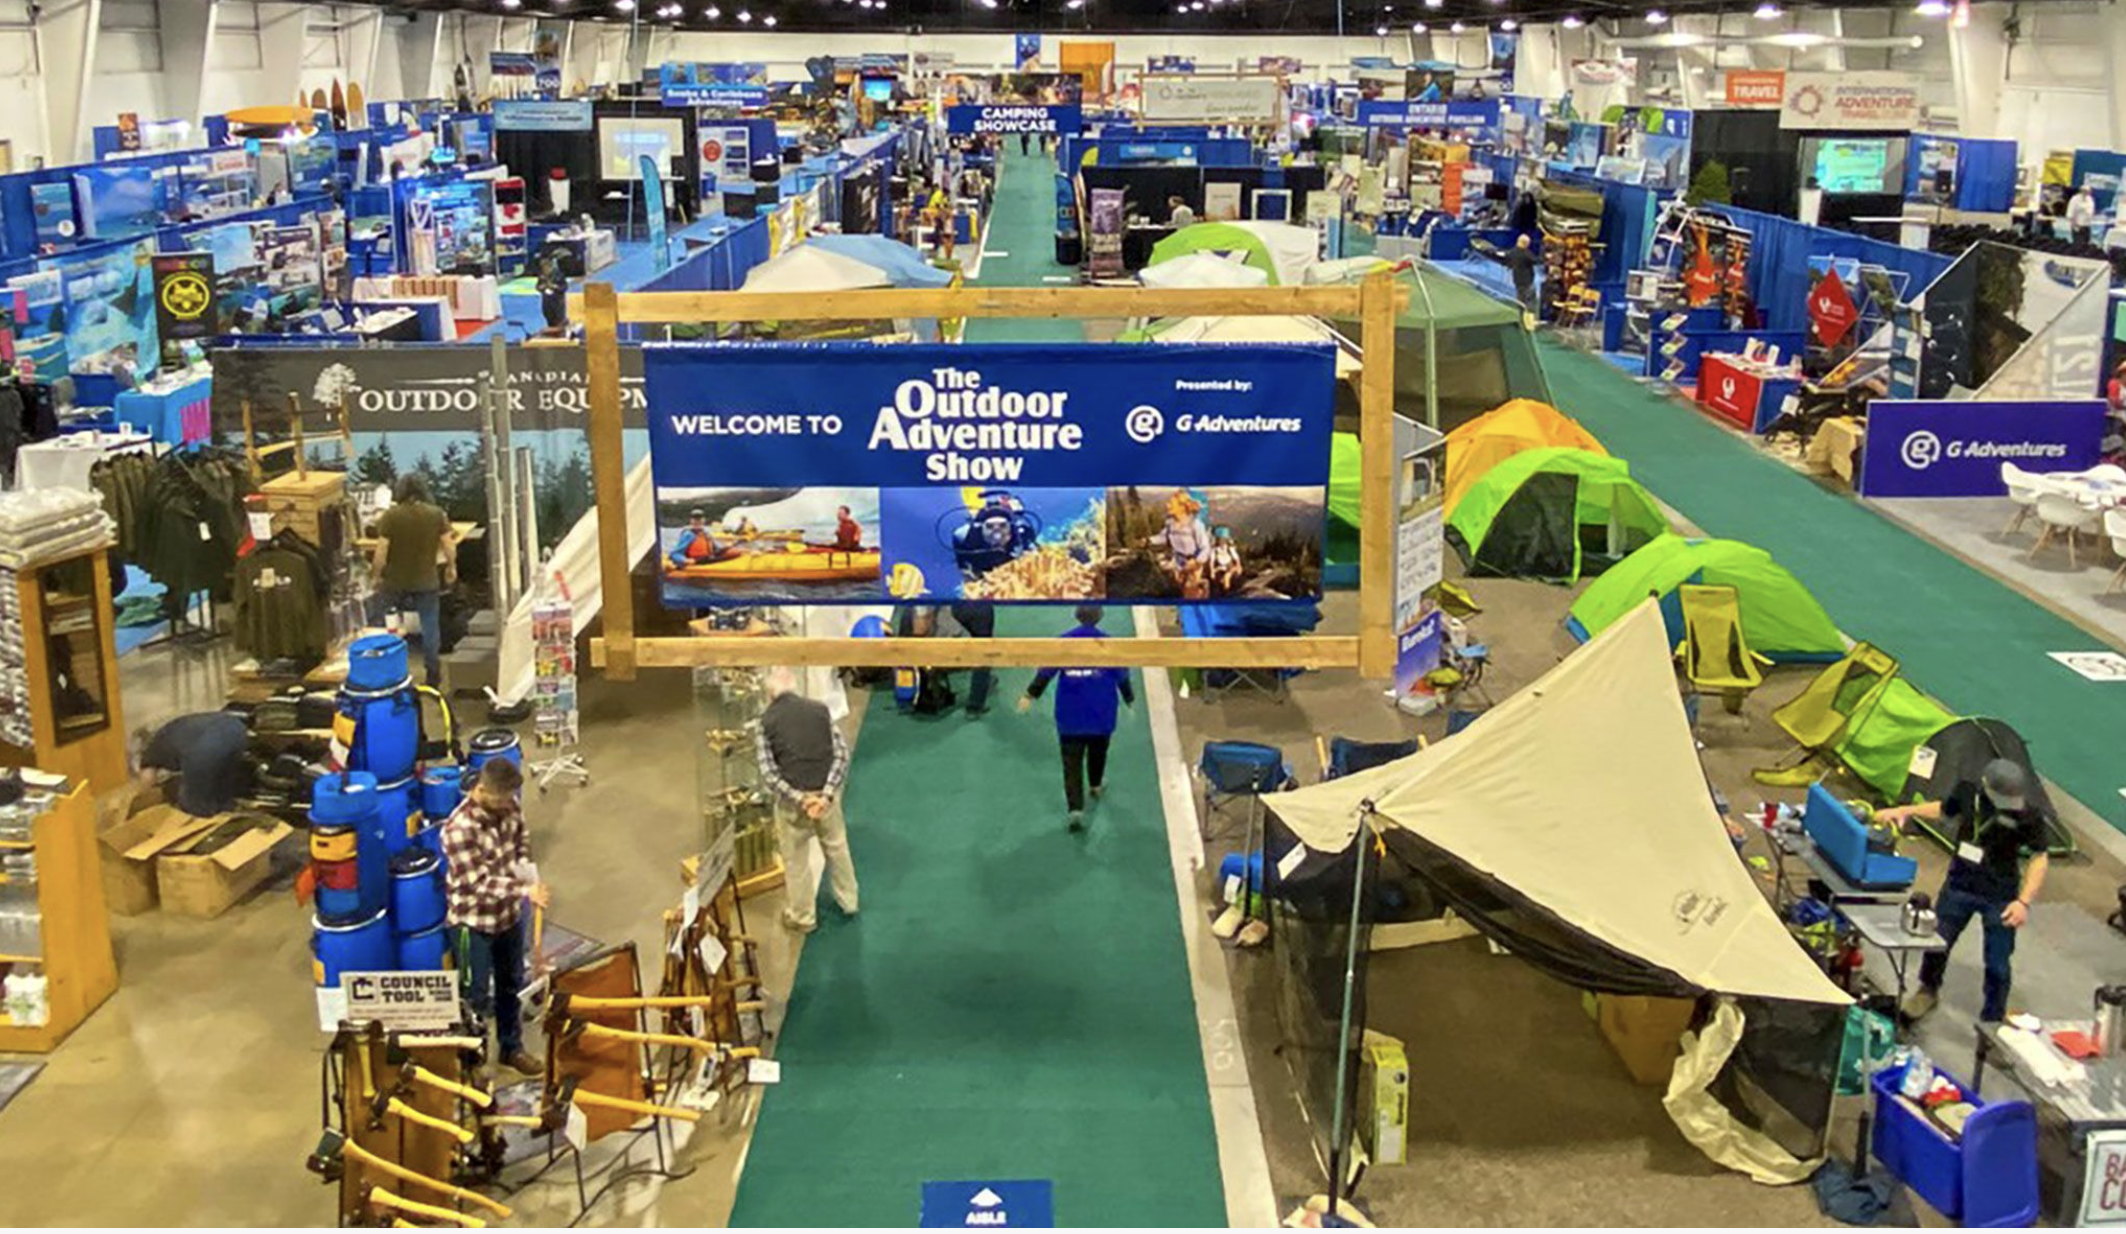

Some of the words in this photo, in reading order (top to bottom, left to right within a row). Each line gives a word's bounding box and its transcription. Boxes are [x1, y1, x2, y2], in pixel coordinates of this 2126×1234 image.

[1733, 85, 1780, 98] TRAVEL
[1834, 96, 1917, 109] ADVENTURE
[981, 107, 1048, 119] CAMPING
[973, 120, 1056, 132] SHOWCASE
[932, 367, 981, 390] The
[1175, 380, 1232, 391] Presented
[1234, 380, 1253, 393] by:
[359, 387, 526, 412] OUTDOR
[895, 379, 1067, 419] Outdoor
[671, 415, 801, 435] WELCOME
[806, 415, 842, 434] TO
[867, 405, 1083, 451] Adventure
[1175, 414, 1194, 432] G
[1194, 414, 1302, 432] Adventures
[1946, 440, 1963, 458] G
[1963, 440, 2068, 458] Adventures
[926, 453, 1023, 481] Show
[380, 976, 452, 989] COUNCIL
[381, 990, 425, 1003] TOOL
[965, 1210, 1007, 1225] AISLE
